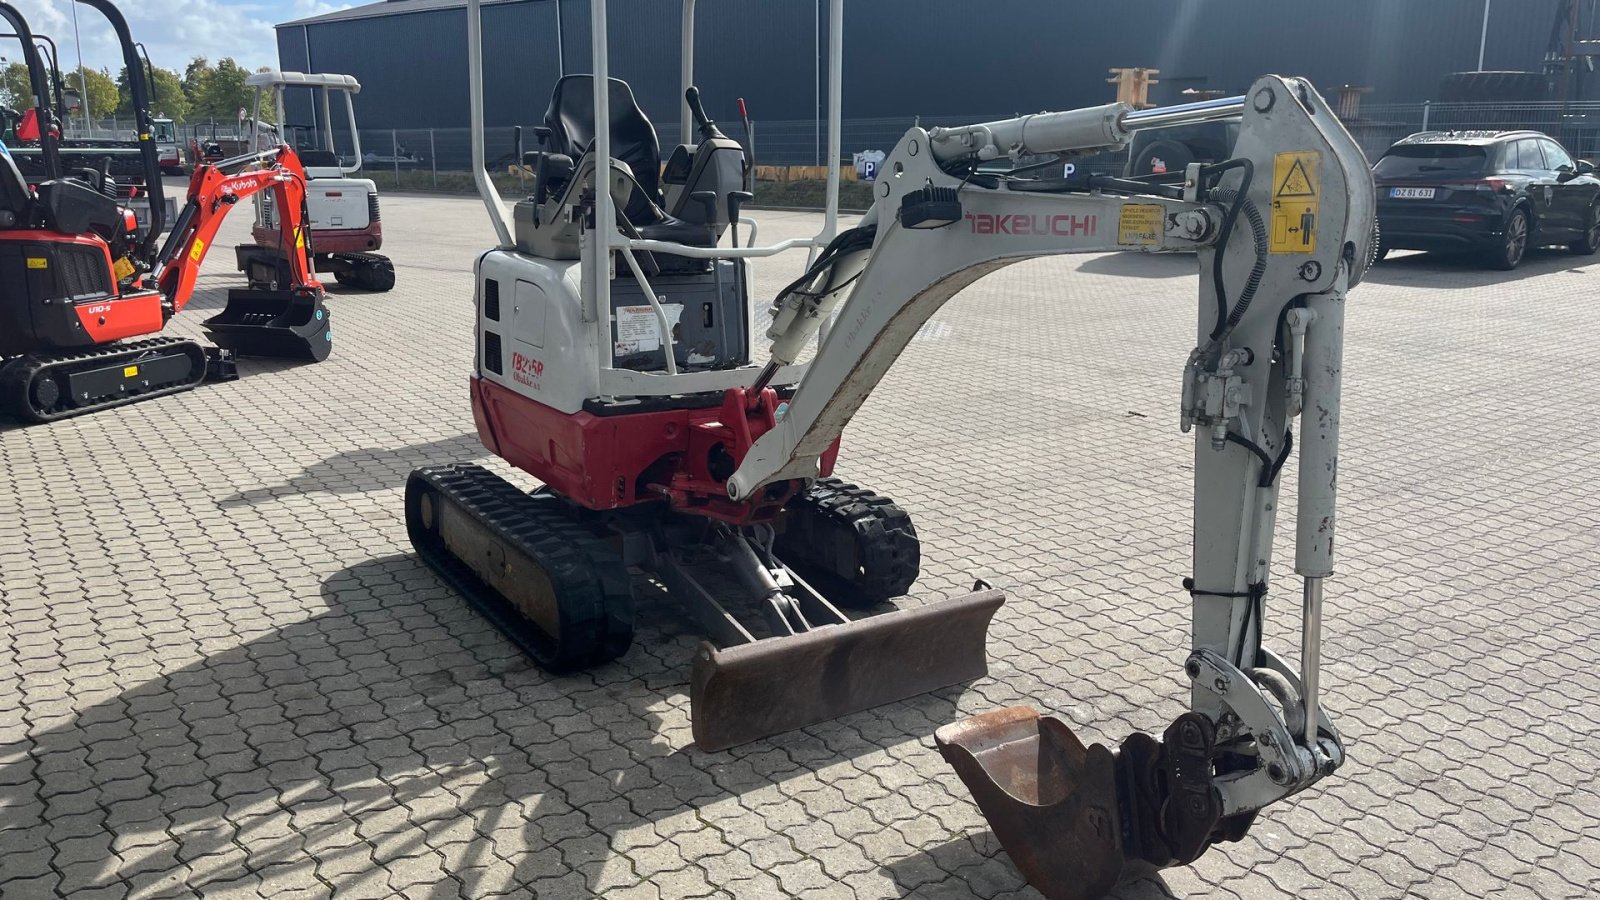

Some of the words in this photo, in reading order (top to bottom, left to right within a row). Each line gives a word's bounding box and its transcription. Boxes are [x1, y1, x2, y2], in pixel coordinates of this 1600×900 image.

[865, 162, 874, 176] P
[1063, 163, 1075, 179] P
[231, 179, 257, 191] Kubota
[1395, 189, 1406, 197] DZ
[1418, 189, 1432, 197] 631
